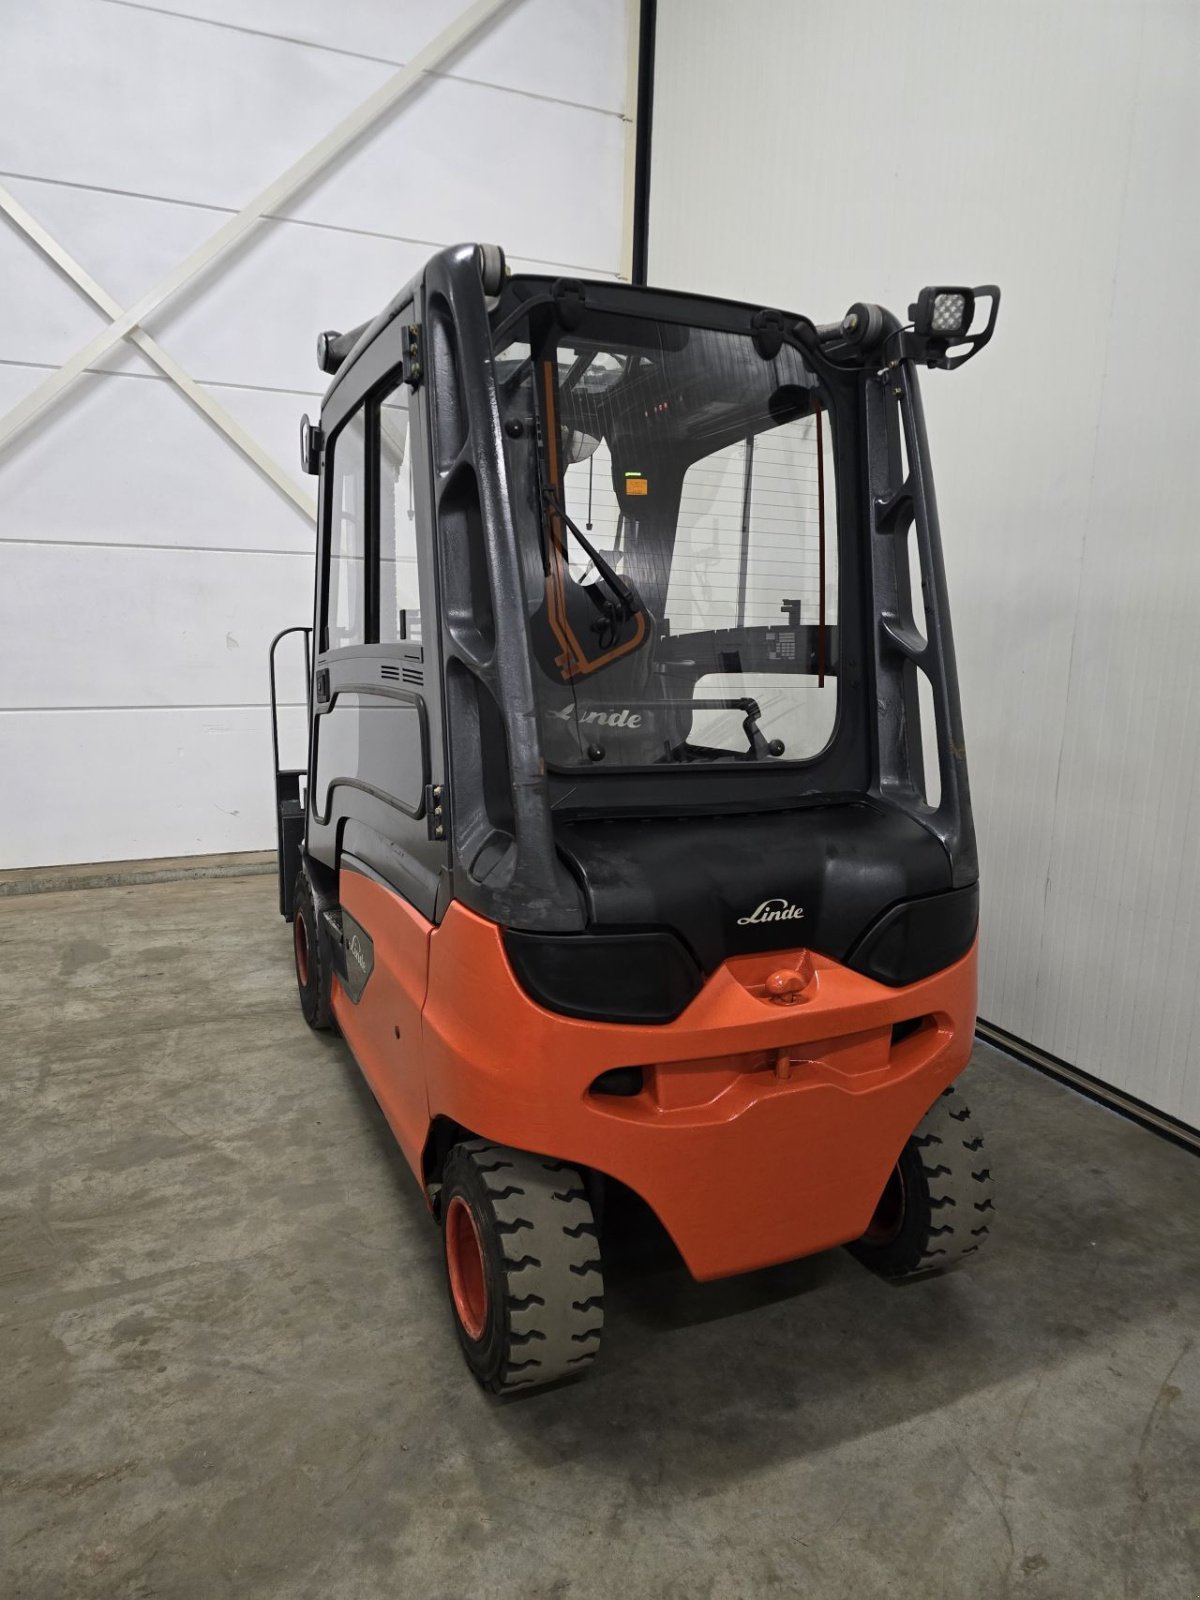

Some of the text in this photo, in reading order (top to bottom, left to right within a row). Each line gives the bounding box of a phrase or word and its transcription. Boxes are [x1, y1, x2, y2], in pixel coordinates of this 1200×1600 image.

[543, 702, 642, 729] Lnde
[737, 899, 805, 925] Linde
[348, 935, 366, 973] Linde
